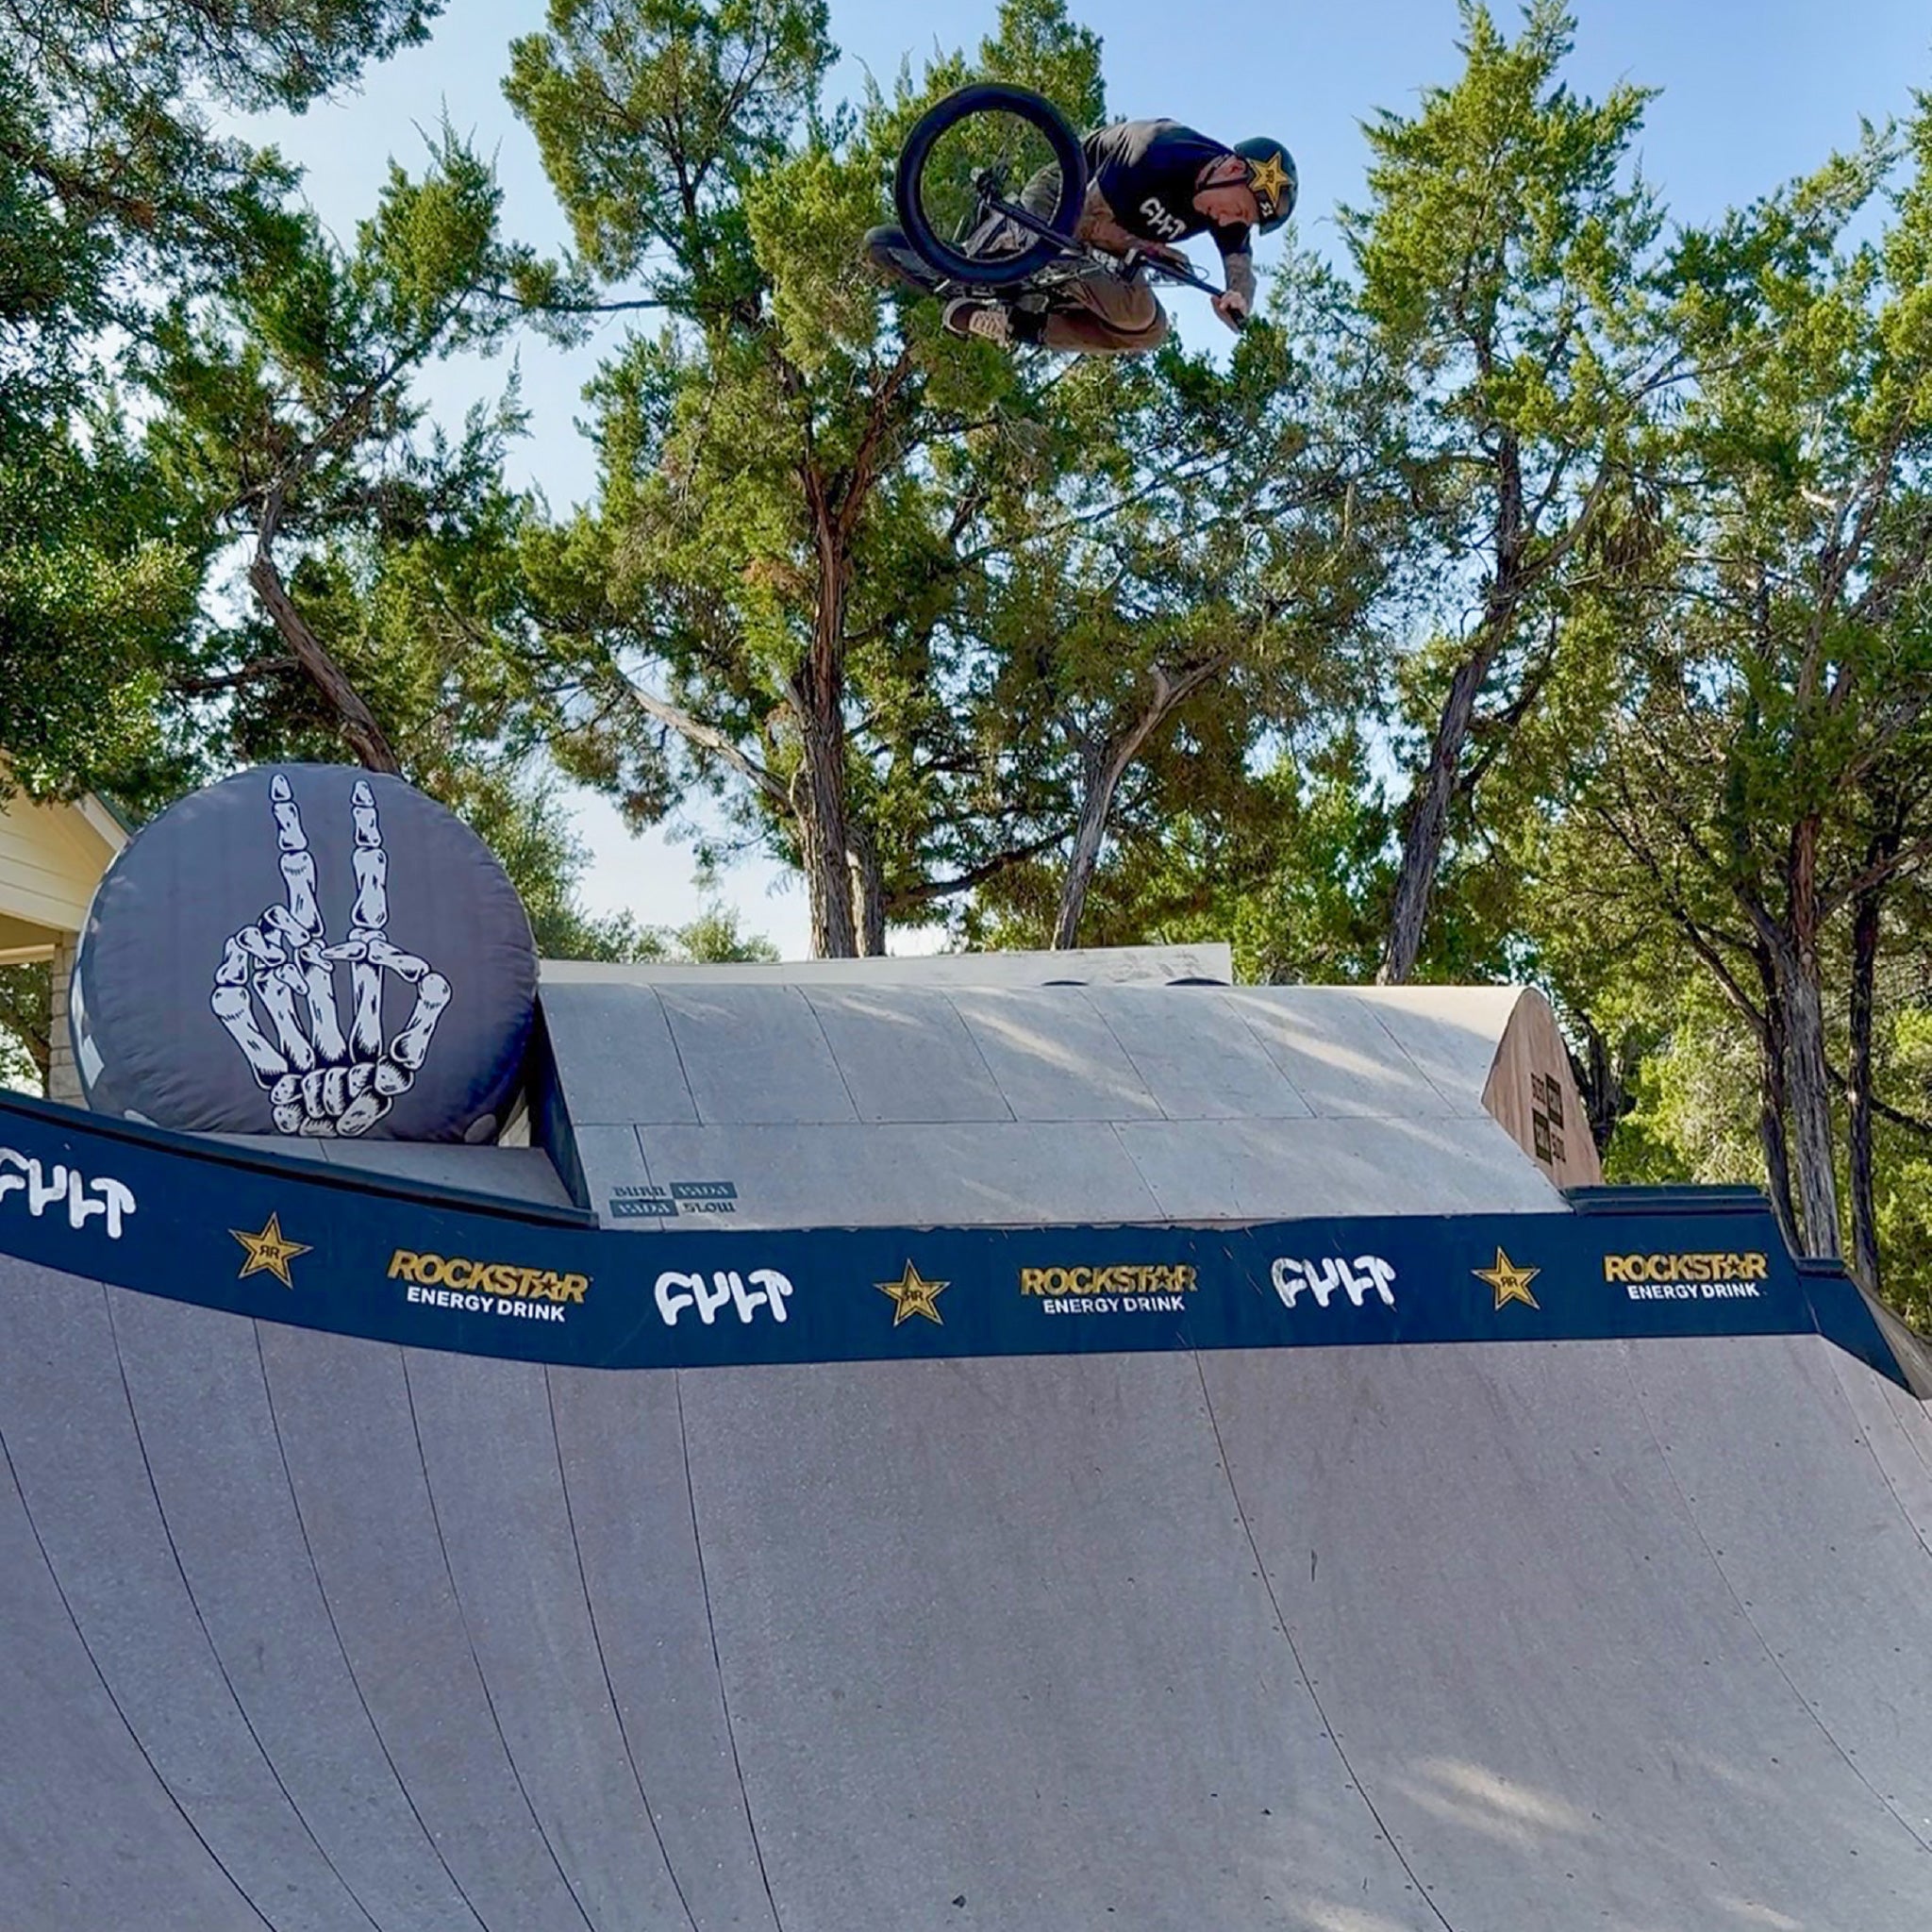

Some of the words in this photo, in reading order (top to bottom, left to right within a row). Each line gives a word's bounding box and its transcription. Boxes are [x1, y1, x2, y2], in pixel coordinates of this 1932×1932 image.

[387, 1248, 591, 1304] ROCKSTAR
[1020, 1264, 1198, 1296] ROCKSTAR
[1271, 1255, 1396, 1308] CULT
[1604, 1253, 1769, 1282] ROCKSTAR
[407, 1286, 494, 1314] ENERGY
[497, 1300, 565, 1323] DRINK
[654, 1268, 793, 1326] CULT
[1043, 1297, 1120, 1315] ENERGY
[1123, 1295, 1185, 1313] DRINK
[1626, 1285, 1698, 1301] ENERGY
[1700, 1283, 1759, 1298] DRINK
